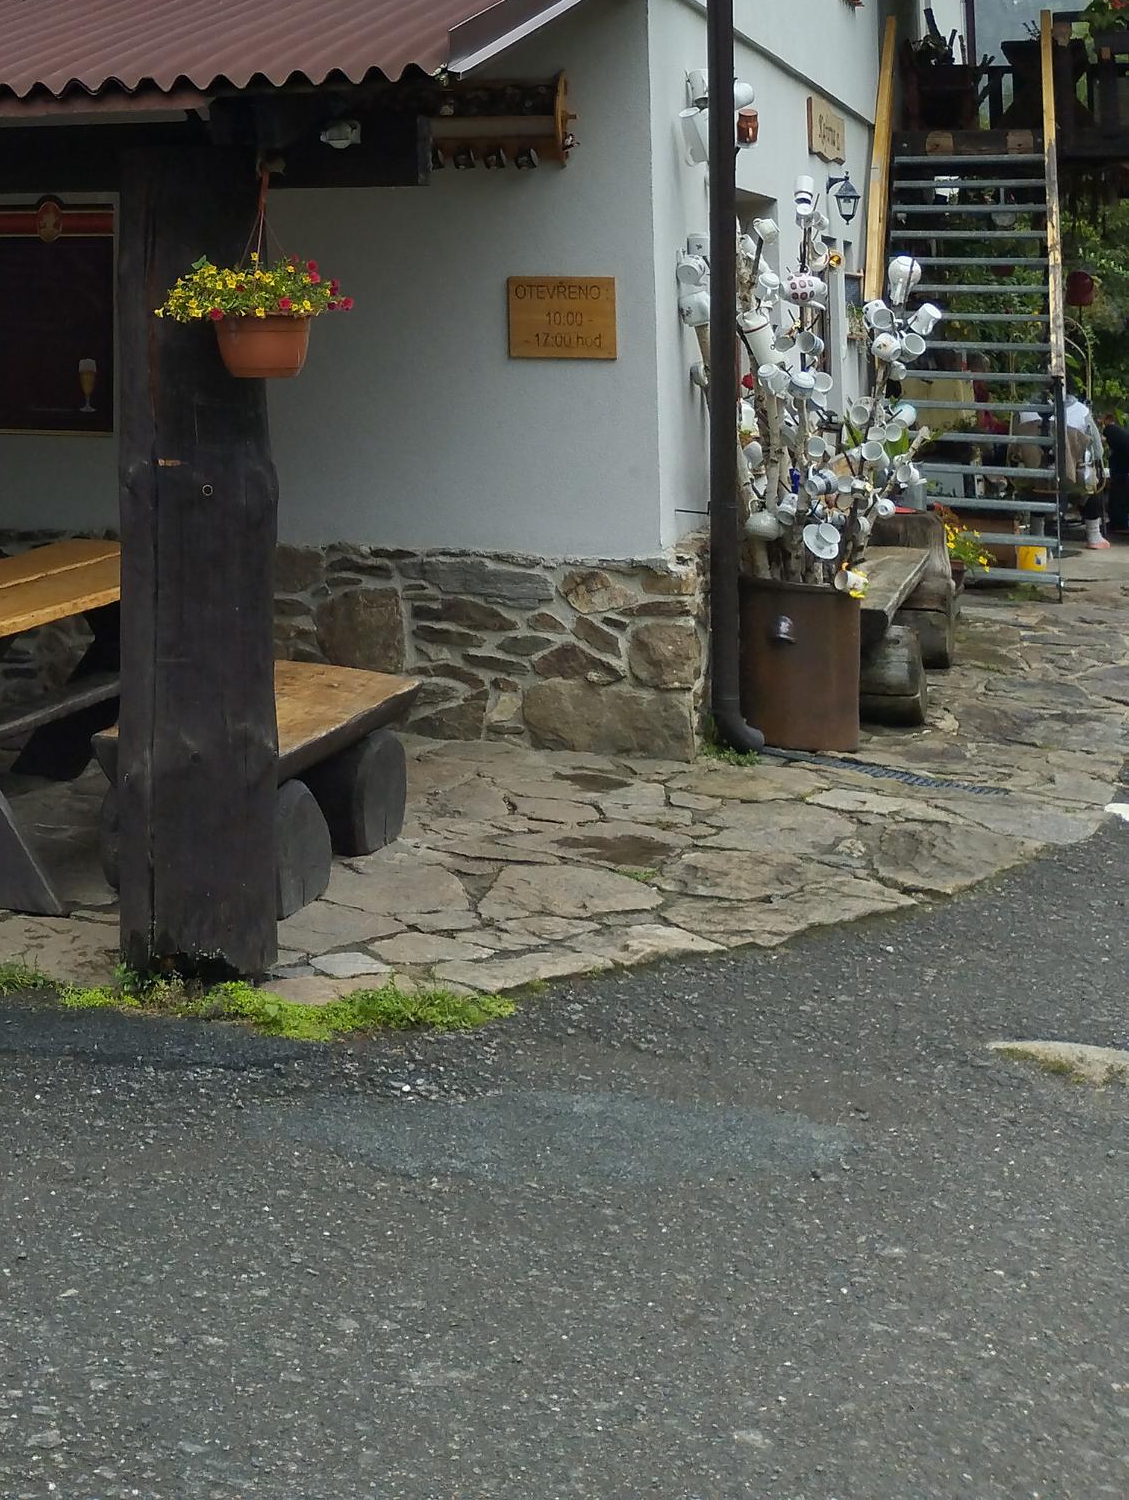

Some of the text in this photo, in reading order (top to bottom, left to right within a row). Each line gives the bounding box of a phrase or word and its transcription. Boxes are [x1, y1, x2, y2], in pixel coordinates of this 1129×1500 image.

[515, 281, 601, 300] OTEVŘENO
[545, 311, 583, 327] 10:00
[534, 332, 571, 348] 17:00
[576, 332, 602, 348] hod
